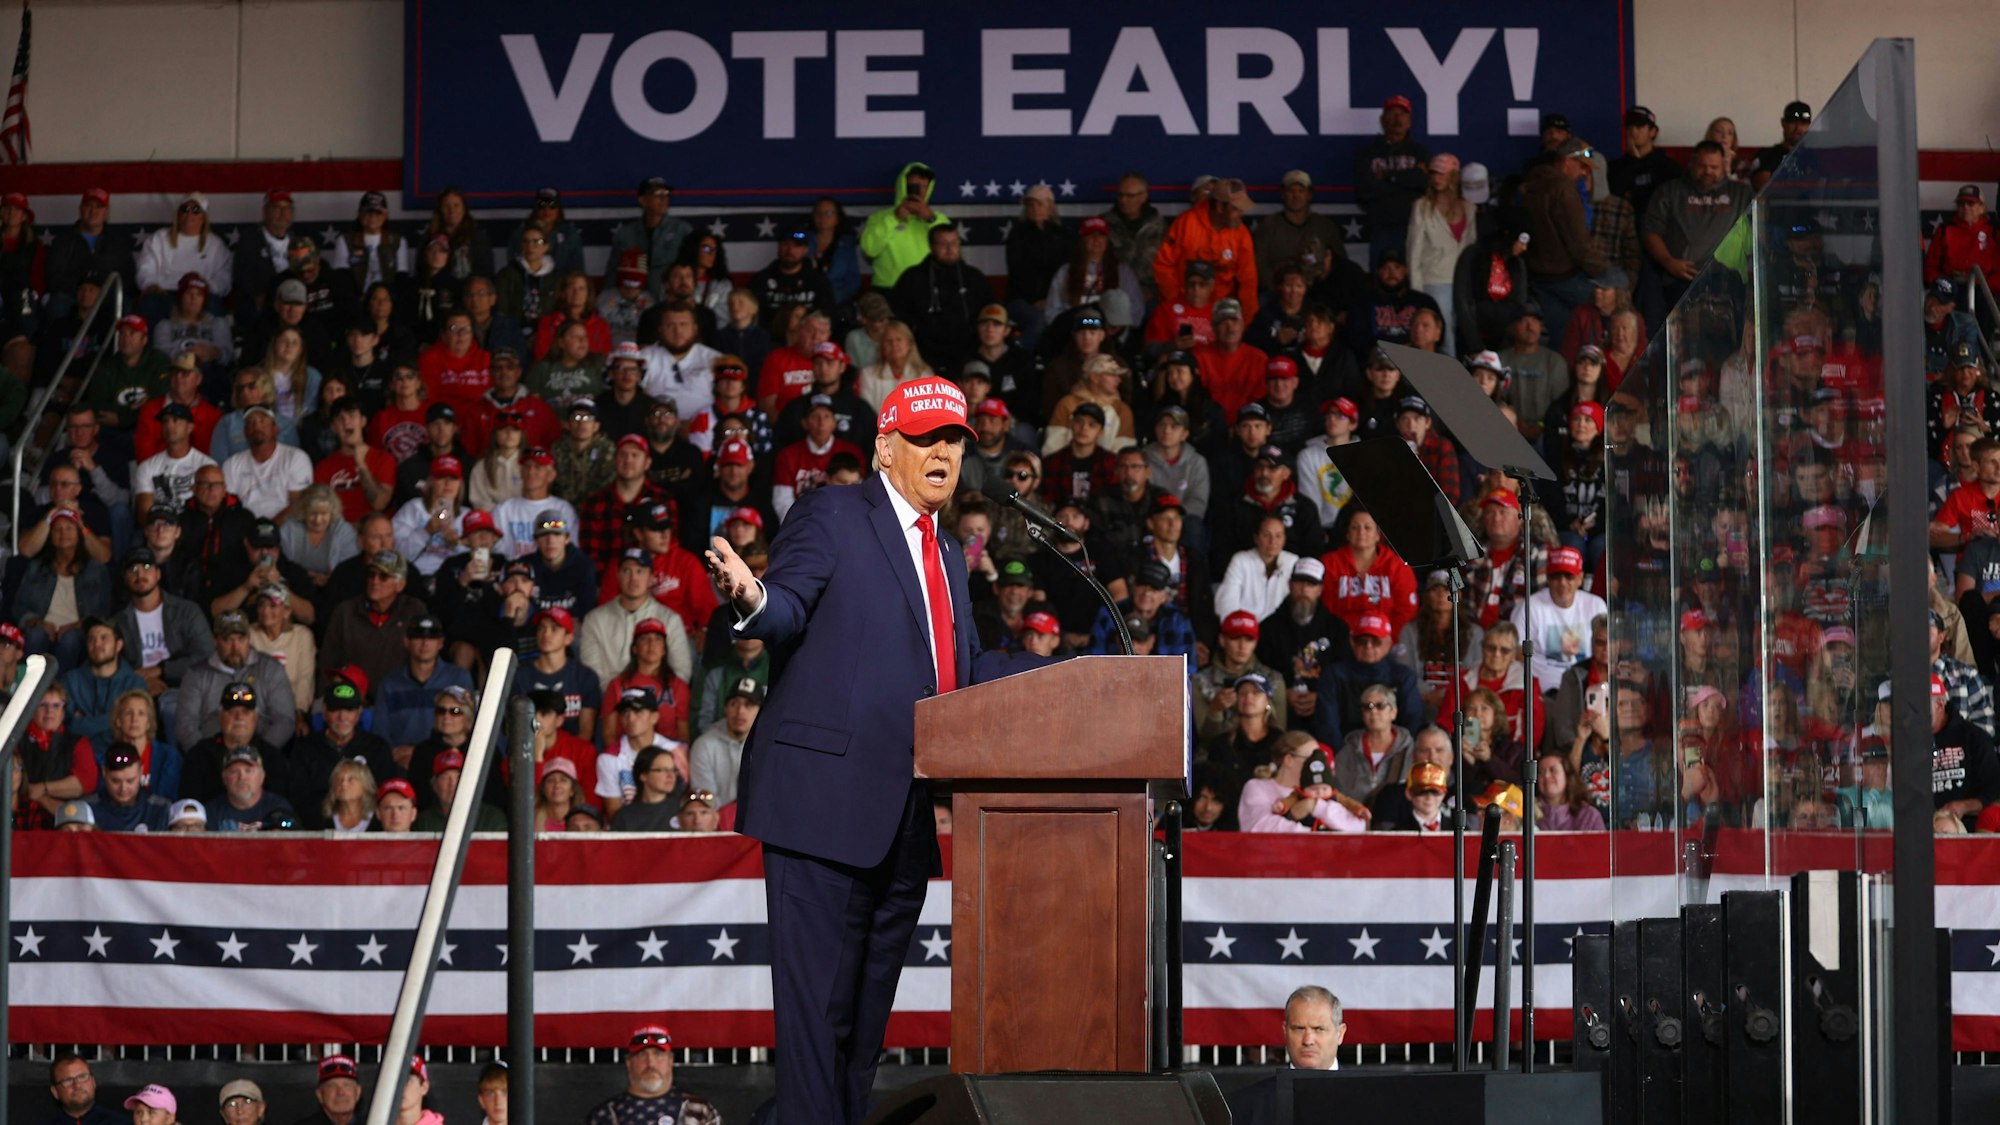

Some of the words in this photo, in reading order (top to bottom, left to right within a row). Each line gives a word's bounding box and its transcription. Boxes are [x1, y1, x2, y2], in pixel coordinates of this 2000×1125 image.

[501, 28, 926, 143] VOTE
[981, 26, 1541, 138] EARLY!
[904, 384, 933, 398] MAKE
[911, 399, 943, 413] GREAT
[943, 401, 965, 418] AGAIN
[1339, 573, 1391, 600] WSNSN
